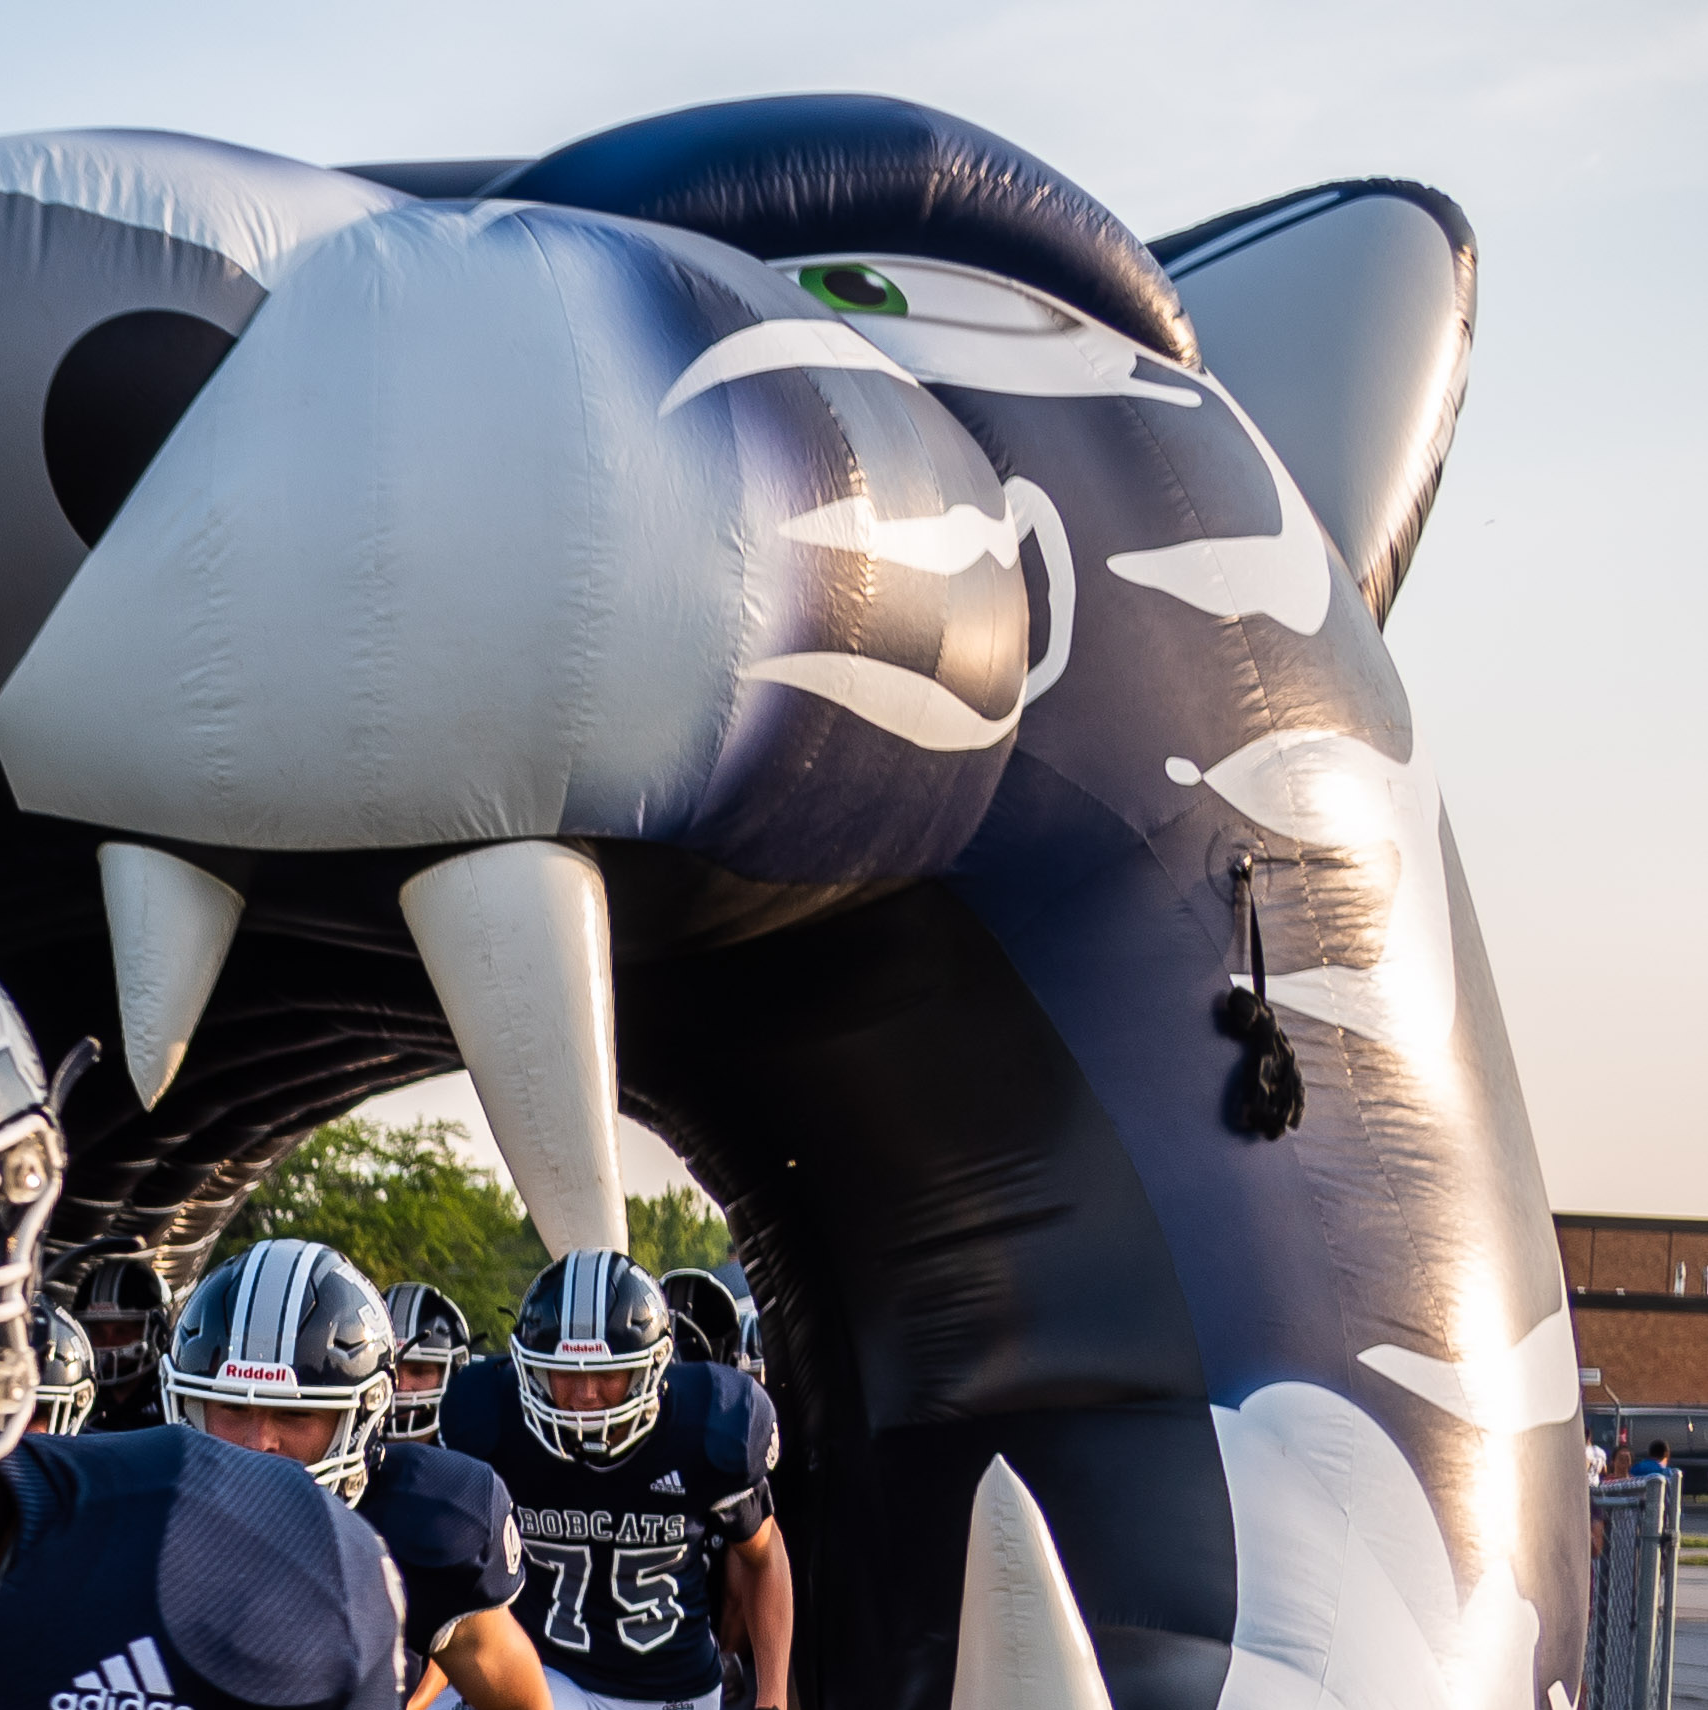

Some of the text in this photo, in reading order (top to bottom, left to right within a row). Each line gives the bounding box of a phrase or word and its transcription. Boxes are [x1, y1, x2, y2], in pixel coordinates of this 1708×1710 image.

[226, 1363, 287, 1382] Riddell
[517, 1505, 686, 1544] BOBCATS
[522, 1539, 689, 1656] 75
